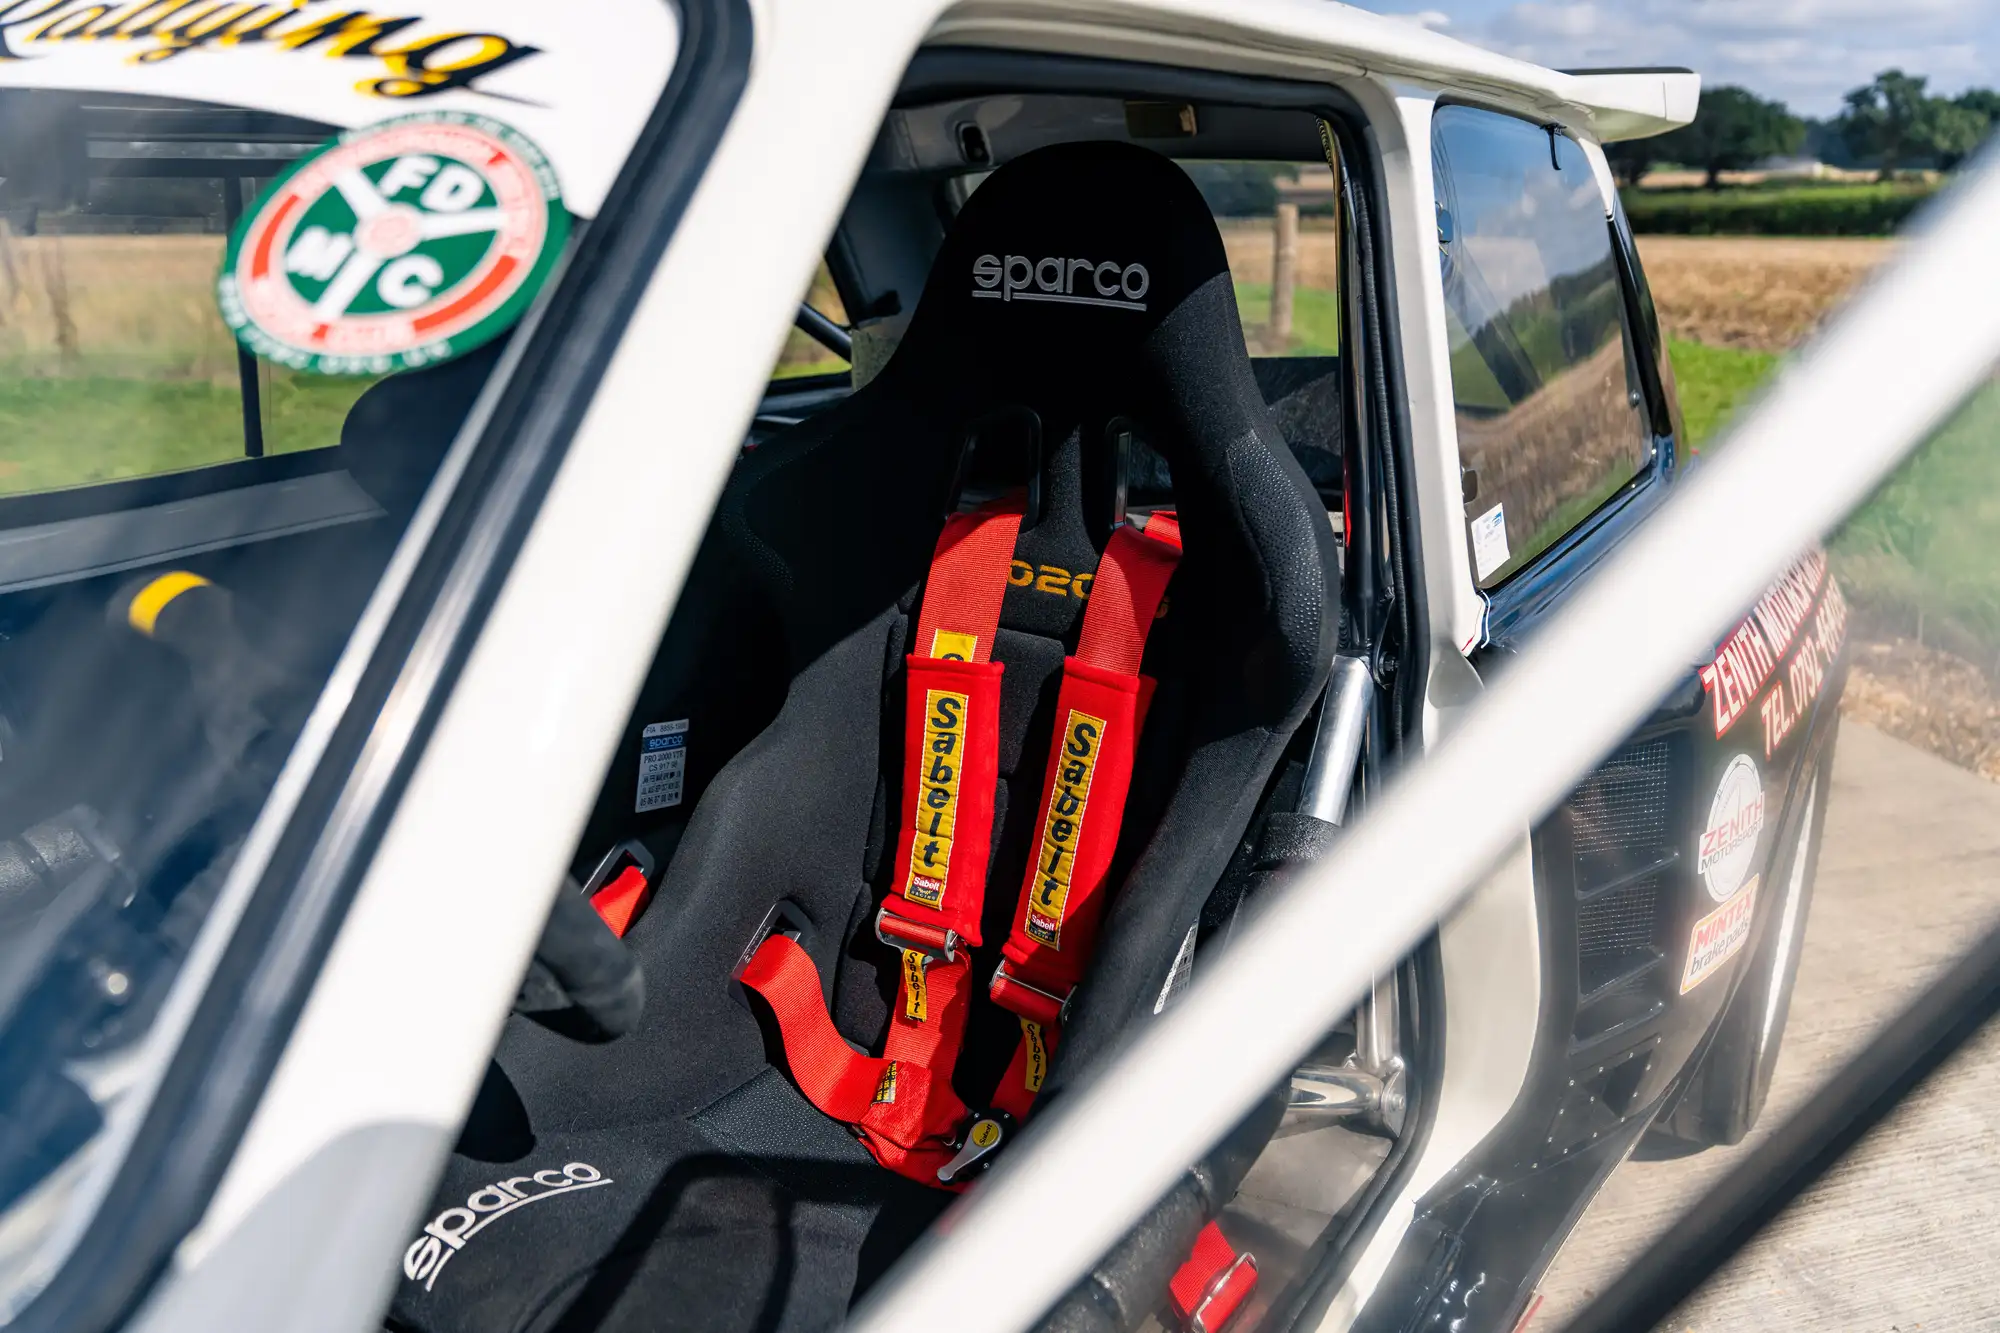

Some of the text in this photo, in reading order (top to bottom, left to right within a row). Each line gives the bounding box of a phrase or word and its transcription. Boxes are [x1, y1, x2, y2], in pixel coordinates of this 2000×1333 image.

[972, 253, 1150, 304] sparco
[1701, 614, 1773, 736] ZENITH
[648, 735, 684, 750] sparco
[921, 696, 963, 868] Sabelt
[1039, 721, 1098, 907] Sabelt
[1701, 817, 1763, 871] MOTORSPORT
[1702, 792, 1763, 856] ZENITH
[913, 876, 940, 891] Sabelt
[1031, 914, 1055, 931] Sabelt
[1694, 887, 1753, 954] MINTEX
[907, 952, 920, 1013] Sabelt
[1690, 941, 1726, 976] brake
[1027, 1023, 1041, 1087] Sabelt
[403, 1161, 601, 1281] sparco
